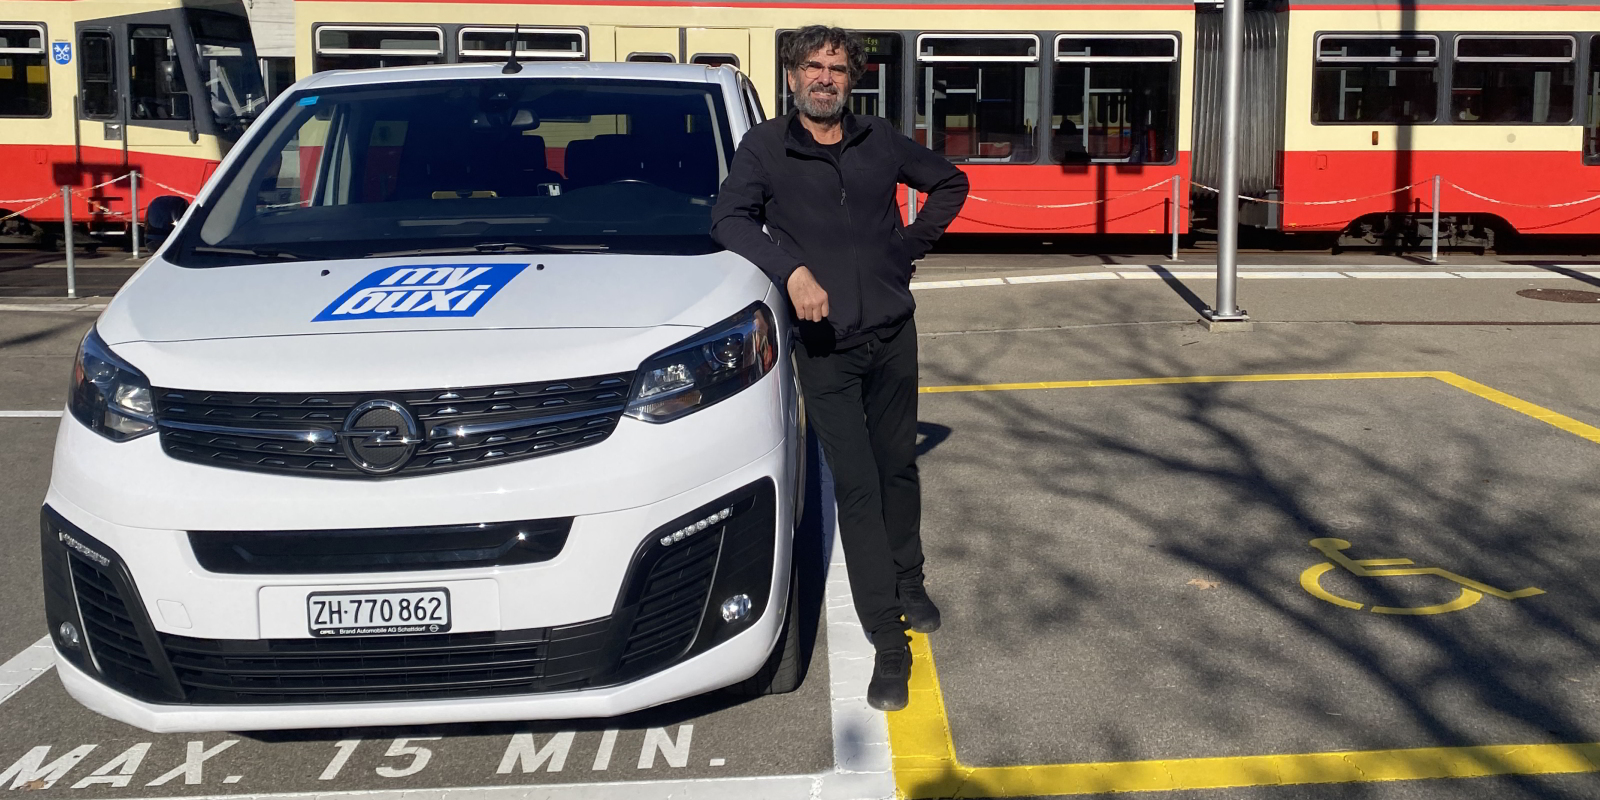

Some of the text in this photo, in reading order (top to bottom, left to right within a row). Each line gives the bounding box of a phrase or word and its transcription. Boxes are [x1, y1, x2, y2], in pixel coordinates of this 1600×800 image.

[379, 267, 493, 290] my
[331, 284, 492, 316] buxi
[399, 597, 442, 622] 862
[357, 626, 387, 634] Automobile
[398, 625, 426, 633] Schattdorf
[0, 724, 726, 790] MAX. 15 MIN.
